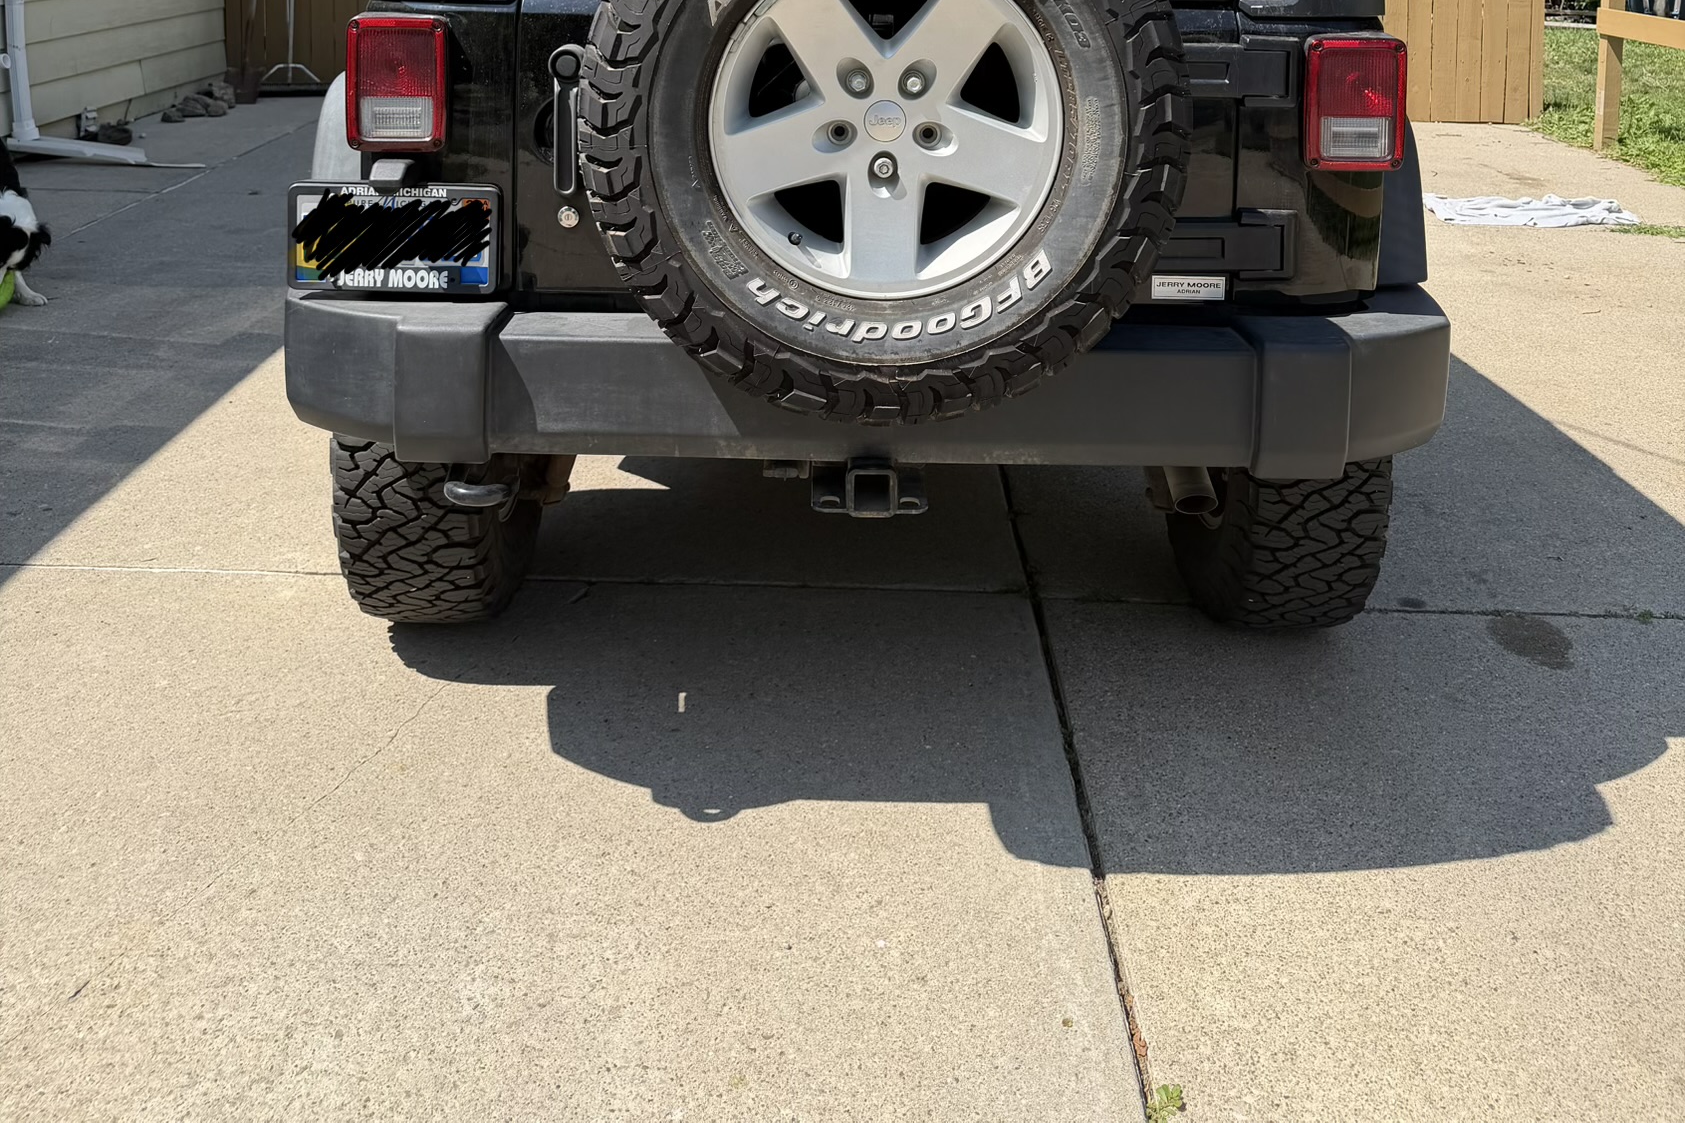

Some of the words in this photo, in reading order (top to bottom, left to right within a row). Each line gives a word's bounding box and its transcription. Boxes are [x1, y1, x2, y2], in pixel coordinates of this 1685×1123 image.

[868, 114, 902, 128] Jeep
[340, 187, 380, 197] ADRIA
[393, 187, 447, 197] ICHIGAN
[337, 268, 385, 288] JERRY
[387, 269, 449, 289] MOORE
[745, 249, 1053, 344] BFGoodrich
